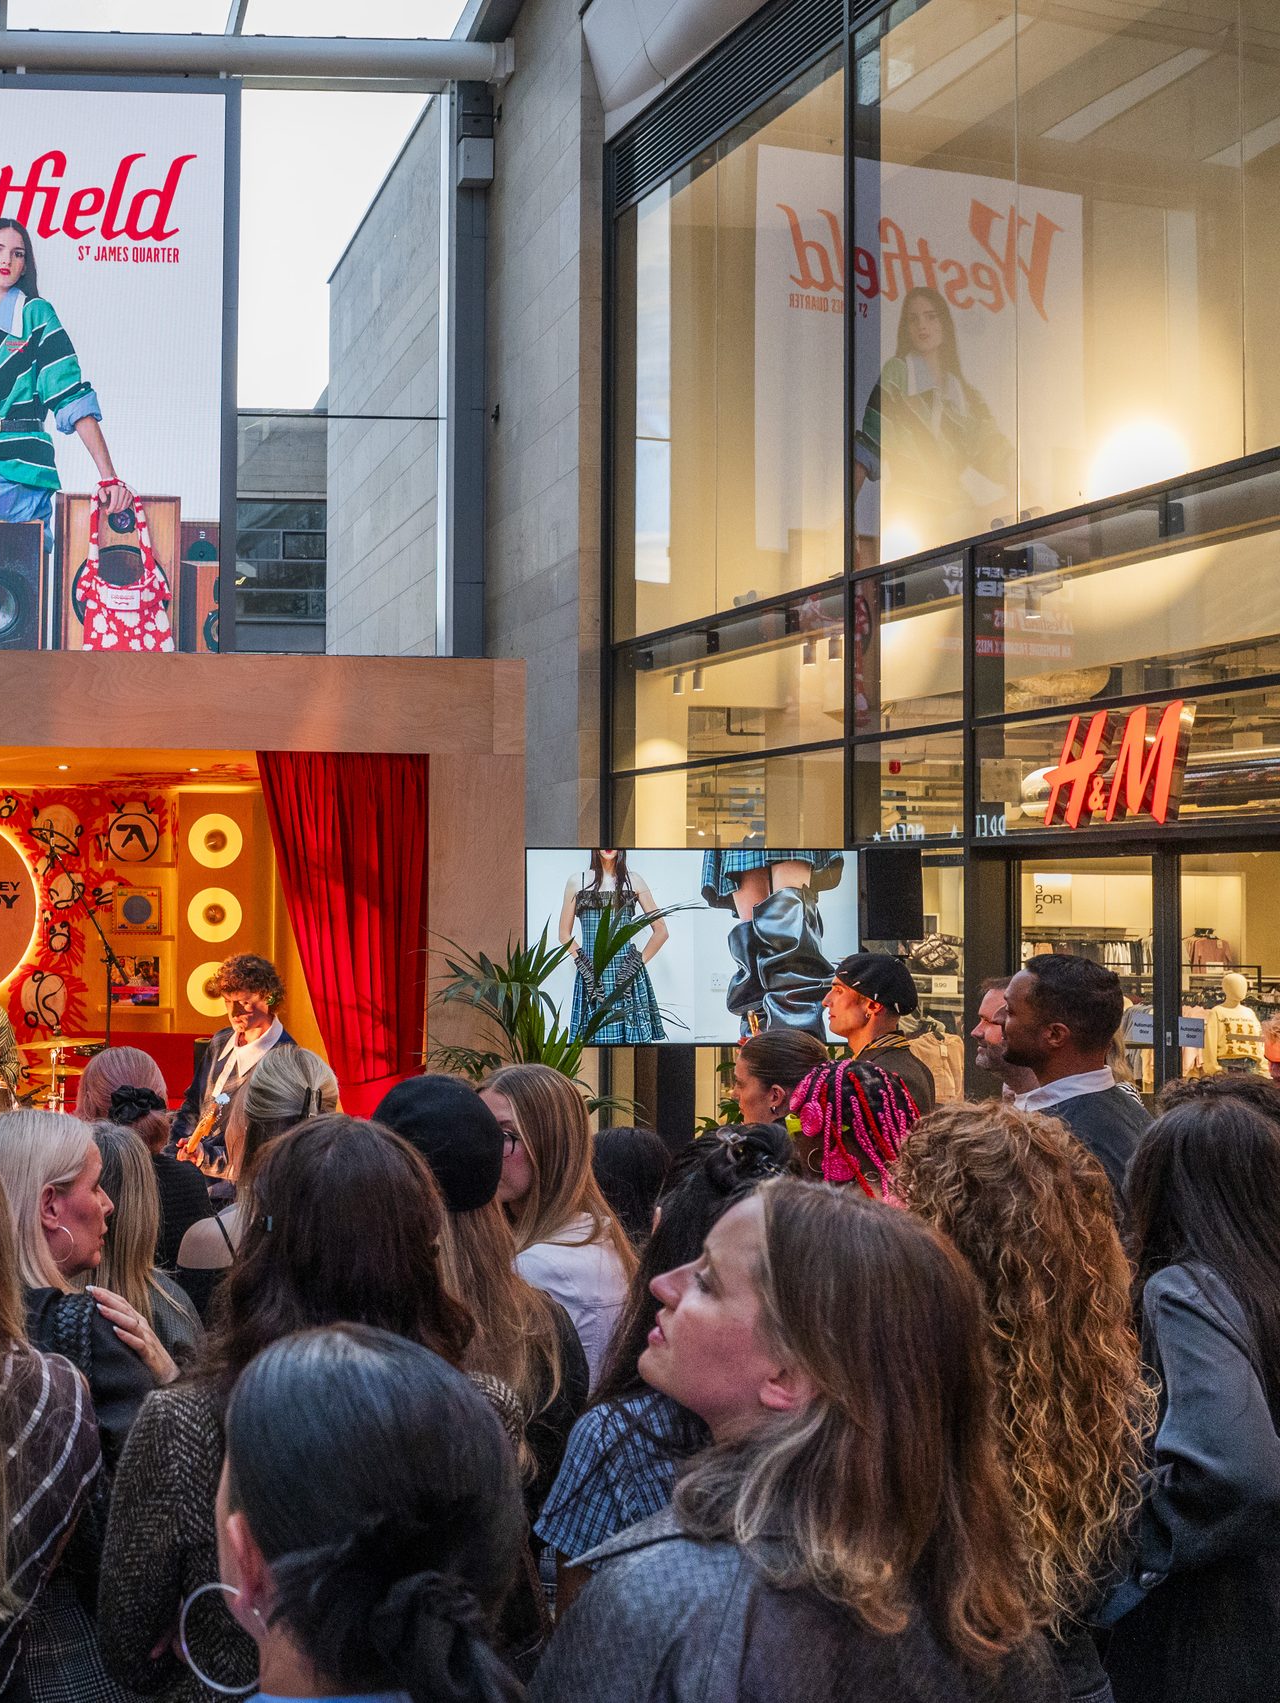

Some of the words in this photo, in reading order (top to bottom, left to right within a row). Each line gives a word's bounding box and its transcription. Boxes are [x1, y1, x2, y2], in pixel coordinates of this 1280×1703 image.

[94, 246, 129, 262] JAMES
[132, 247, 180, 263] QUARTER
[1042, 699, 1184, 829] H&M
[1035, 884, 1043, 894] 3
[1035, 894, 1062, 904] FOR
[1035, 904, 1043, 914] 2
